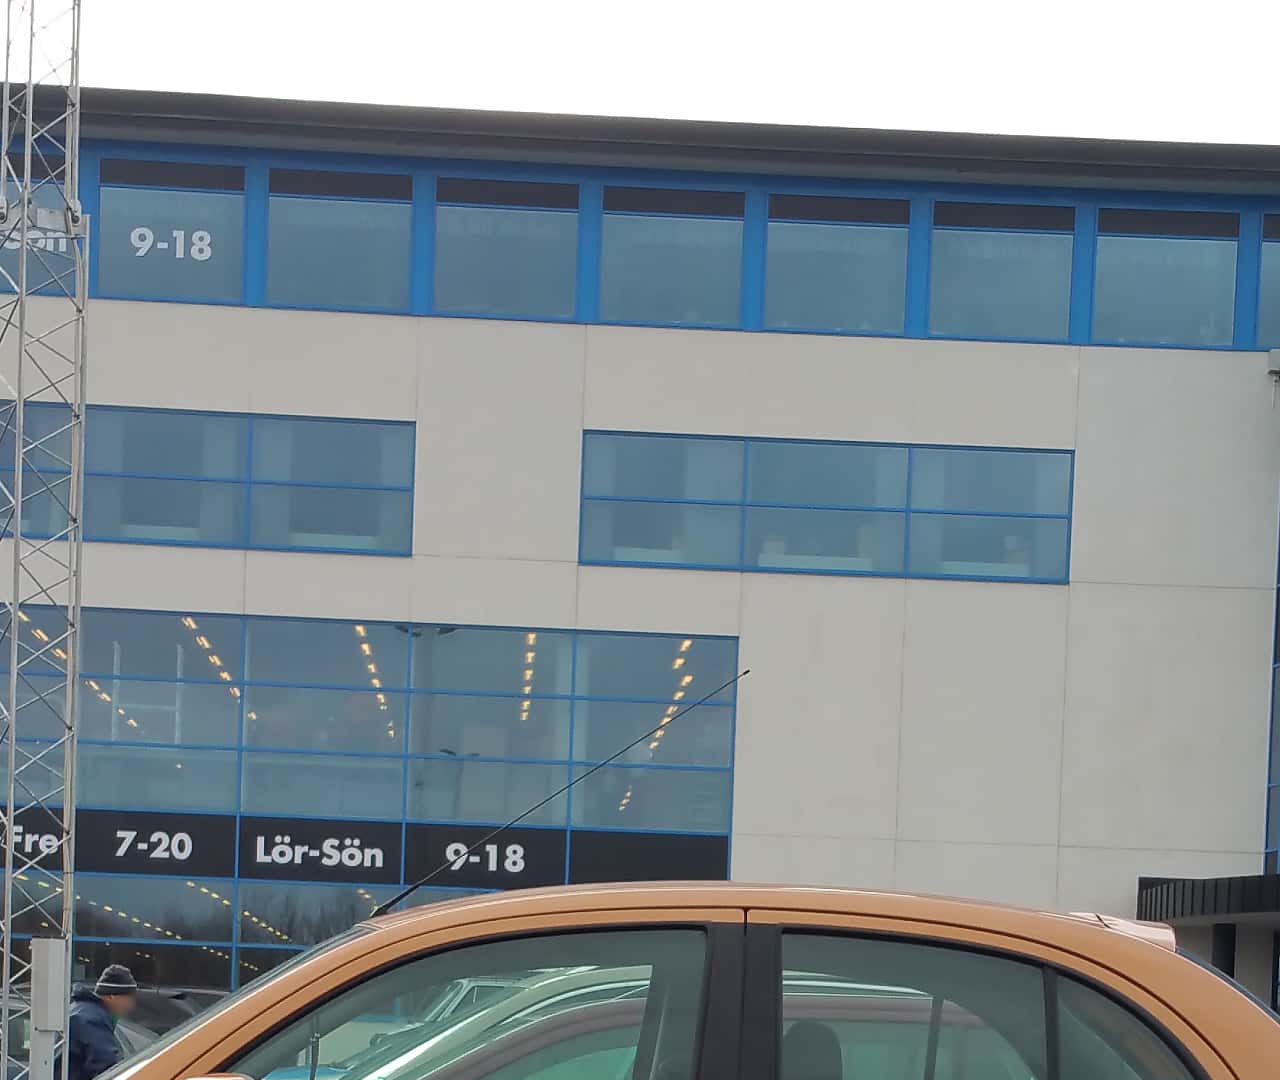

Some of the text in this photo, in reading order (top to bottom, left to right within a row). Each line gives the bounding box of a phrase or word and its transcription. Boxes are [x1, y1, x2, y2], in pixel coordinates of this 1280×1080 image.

[129, 227, 213, 261] 9-18
[115, 830, 194, 861] 7-20
[255, 834, 384, 869] Lör-Sön
[444, 842, 525, 873] 9-18
